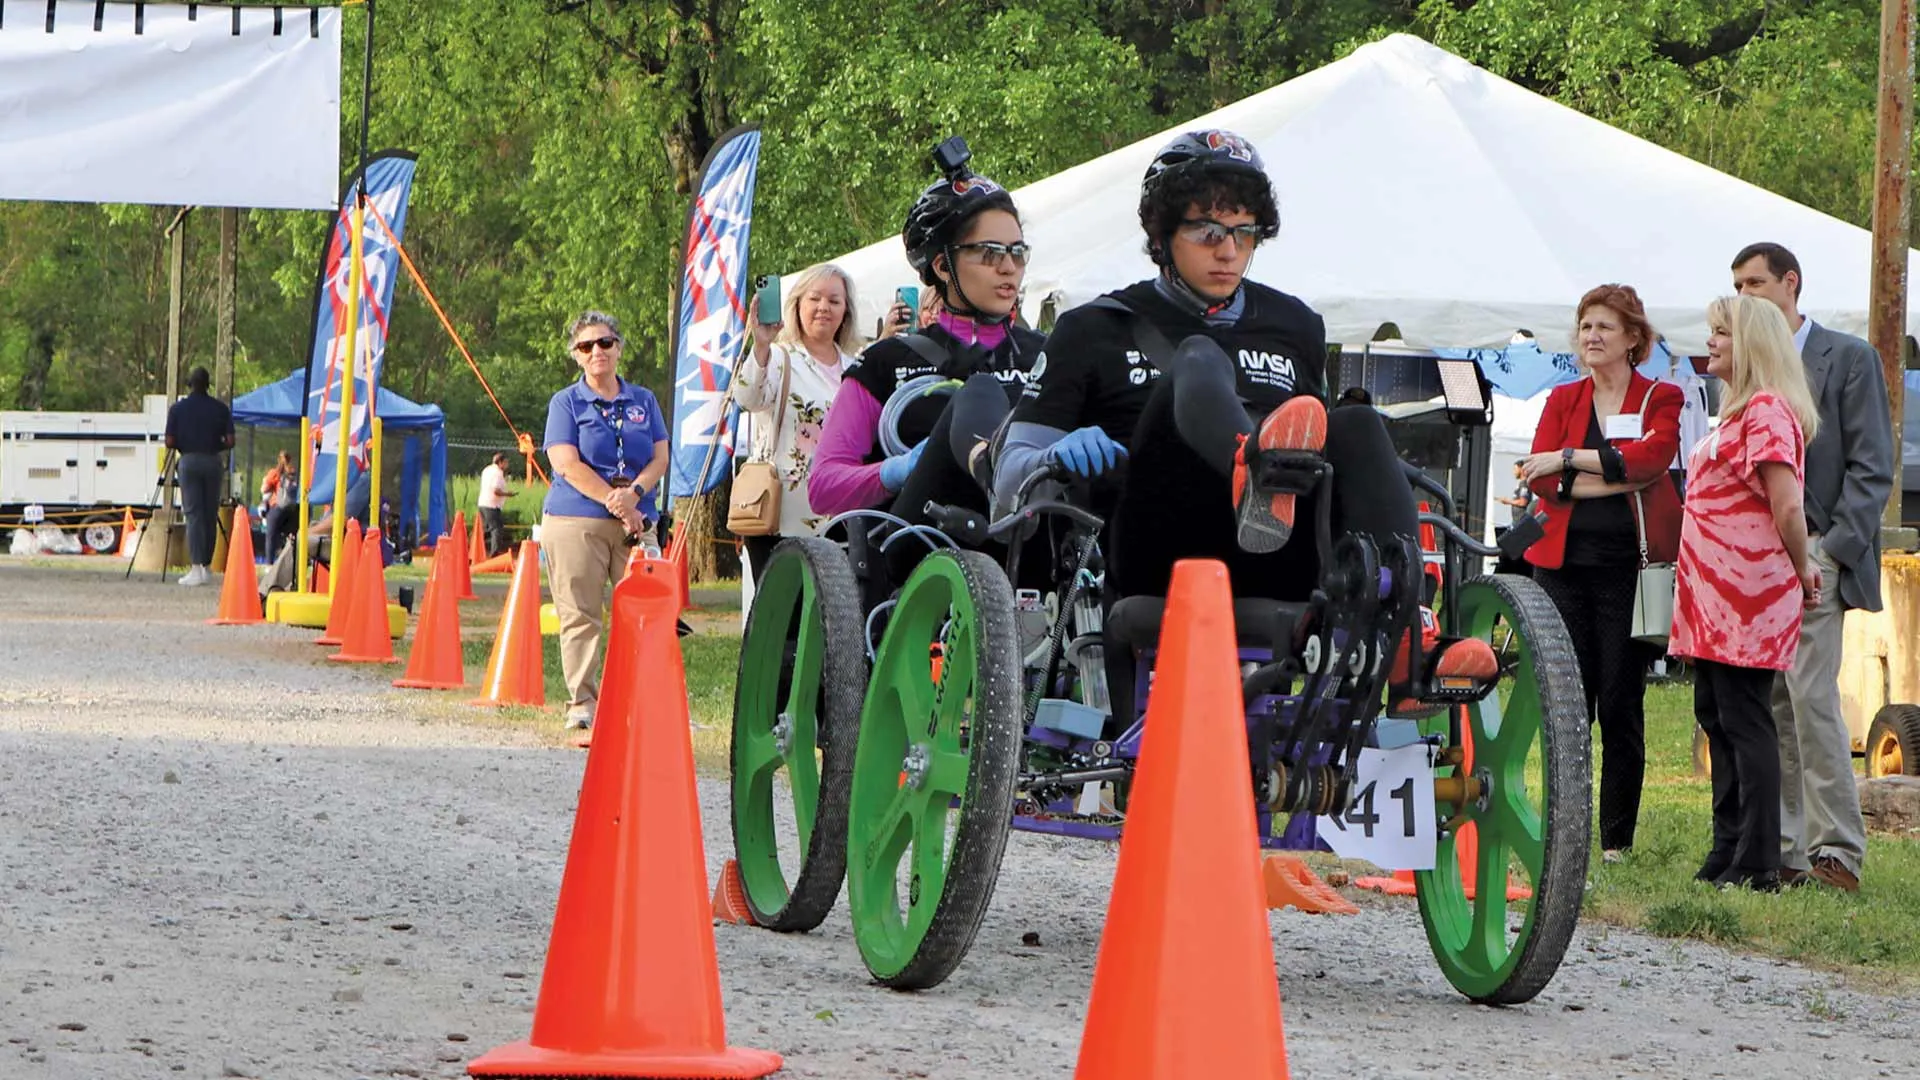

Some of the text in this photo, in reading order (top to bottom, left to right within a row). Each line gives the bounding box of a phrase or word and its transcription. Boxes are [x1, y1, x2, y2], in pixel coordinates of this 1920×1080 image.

[678, 157, 751, 452] NASA
[1238, 349, 1296, 381] NASA
[1329, 777, 1416, 838] 41
